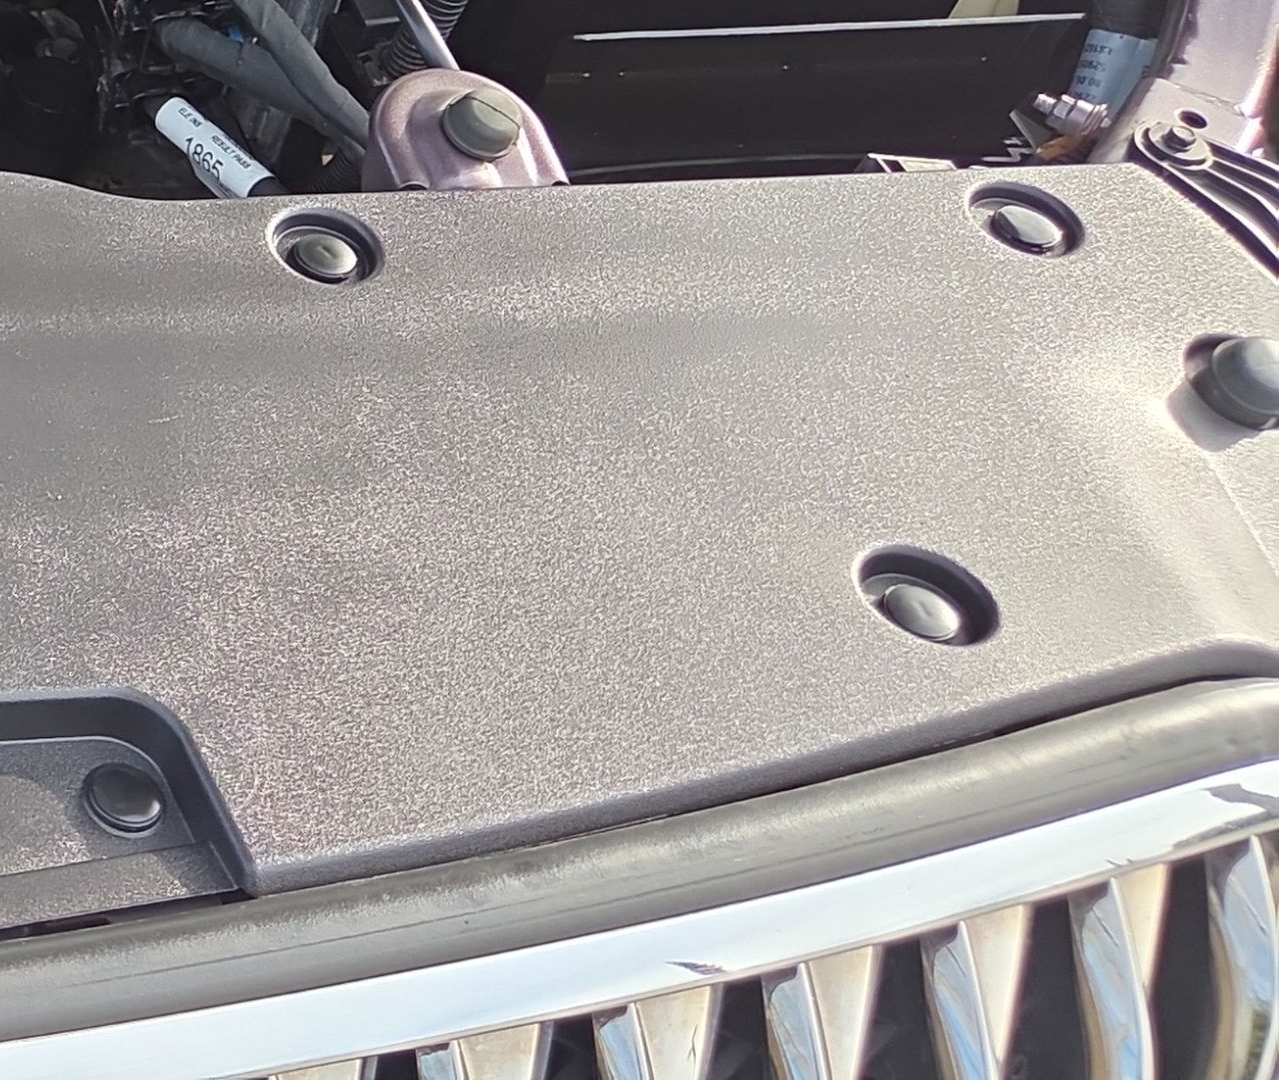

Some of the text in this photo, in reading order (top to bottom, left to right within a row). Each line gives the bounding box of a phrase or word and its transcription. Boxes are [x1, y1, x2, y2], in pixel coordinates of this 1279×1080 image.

[184, 136, 224, 181] 1865
[212, 135, 236, 159] RESULT
[232, 151, 251, 169] PASS
